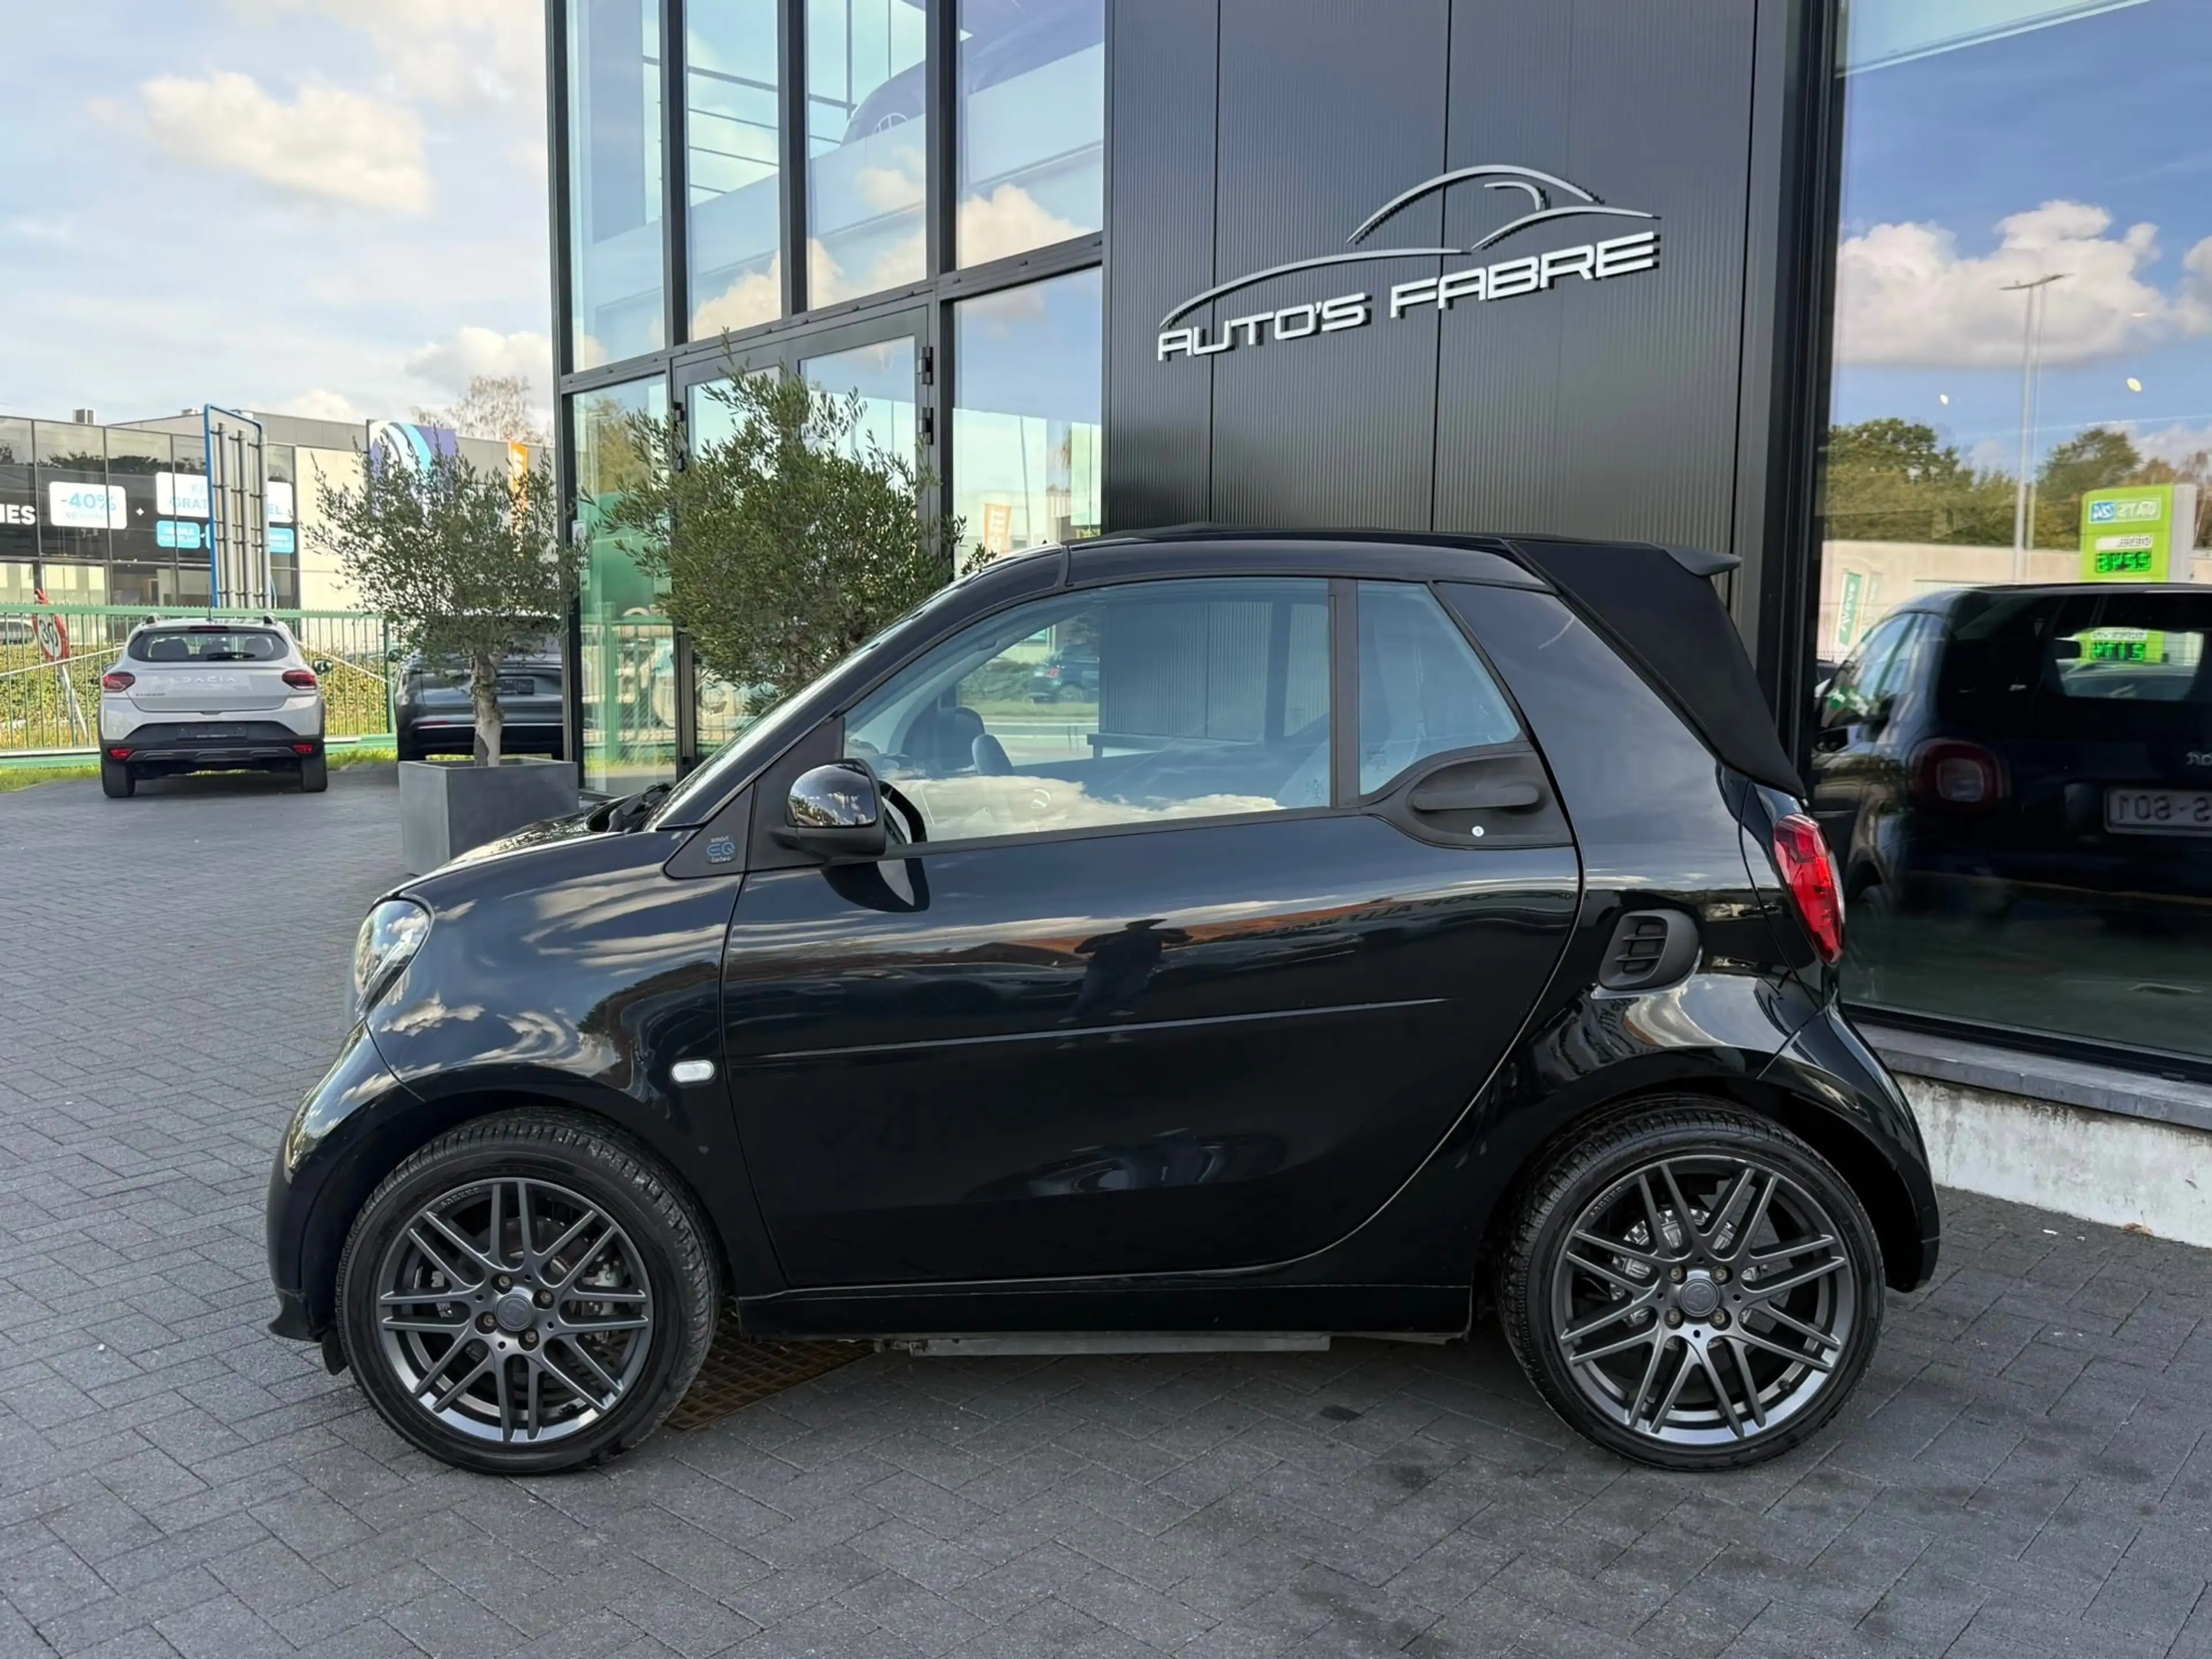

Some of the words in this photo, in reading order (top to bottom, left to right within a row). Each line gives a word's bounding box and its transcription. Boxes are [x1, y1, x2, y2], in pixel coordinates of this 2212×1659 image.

[1158, 293, 1366, 361] AUTO'S
[1391, 232, 1654, 318] FABRE
[60, 492, 117, 511] -40%
[169, 497, 209, 510] GRAT
[181, 675, 236, 683] DACIA
[707, 842, 736, 856] EQ
